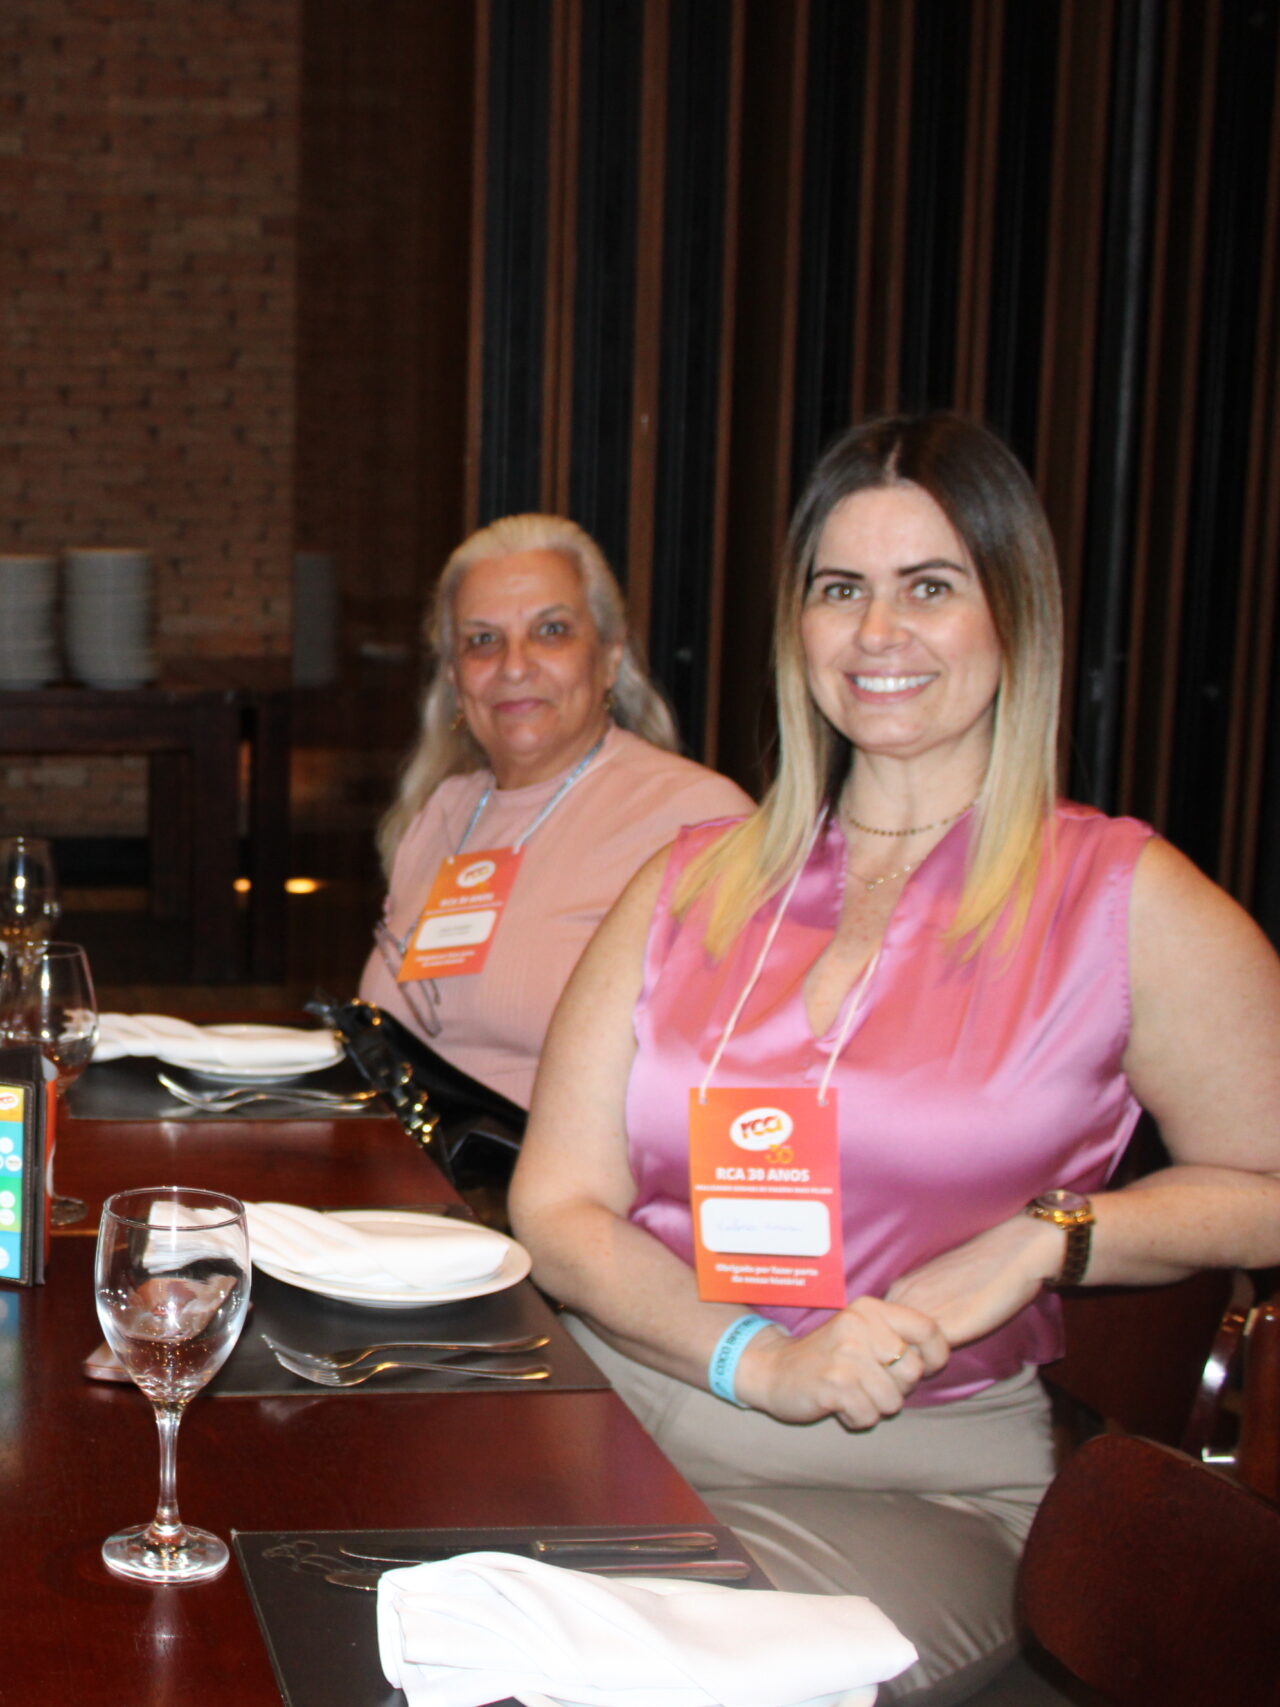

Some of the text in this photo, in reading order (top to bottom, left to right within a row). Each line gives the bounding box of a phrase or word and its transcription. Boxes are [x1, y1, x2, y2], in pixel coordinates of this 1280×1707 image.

[715, 1167, 811, 1182] RCA 30 ANOS
